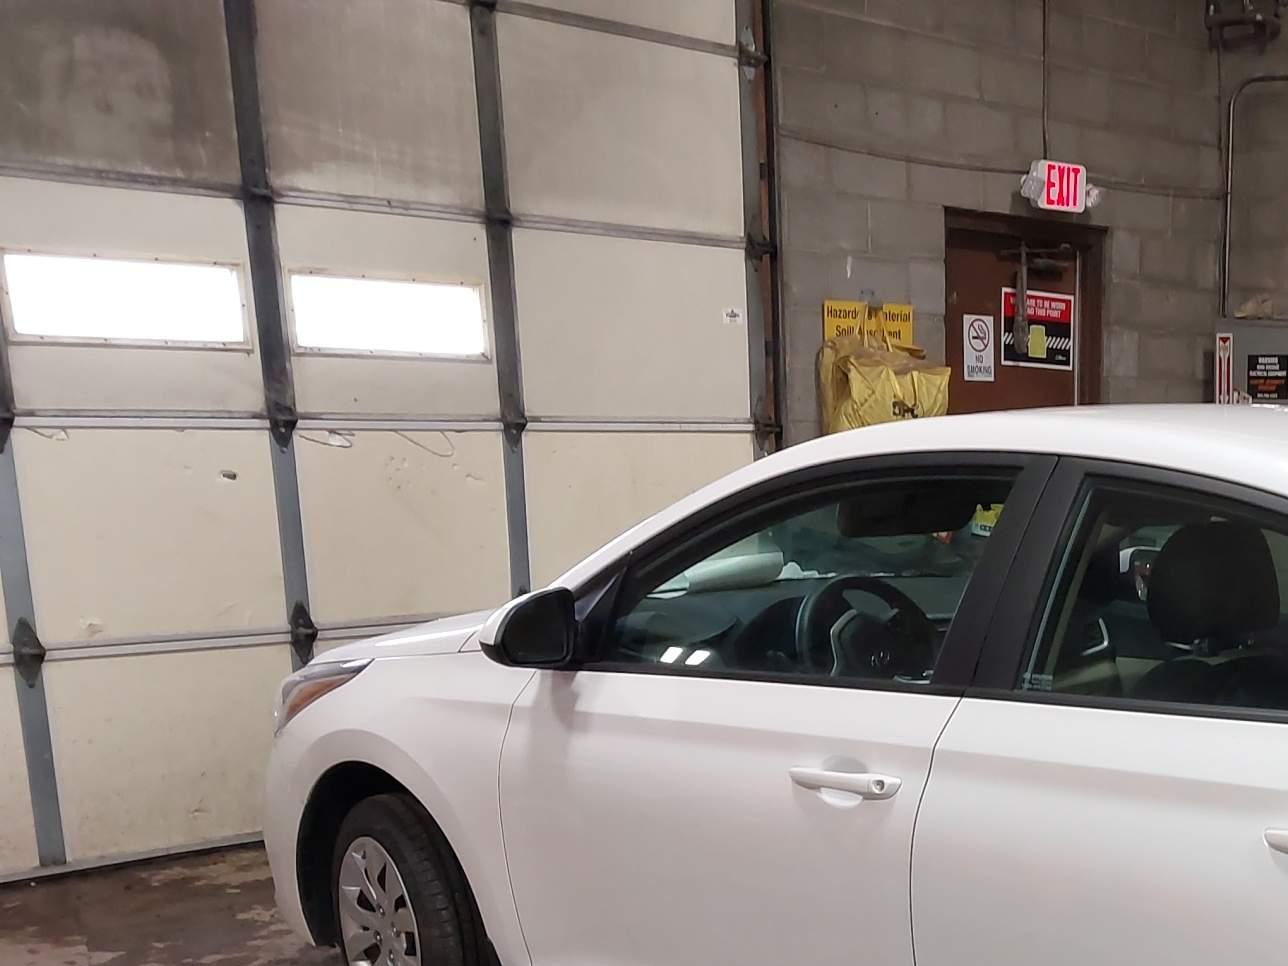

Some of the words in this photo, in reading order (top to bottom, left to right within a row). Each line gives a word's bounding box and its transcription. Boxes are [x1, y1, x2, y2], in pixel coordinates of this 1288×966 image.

[1046, 164, 1081, 207] EXIT
[975, 354, 984, 364] NO
[967, 364, 992, 375] SMOKING
